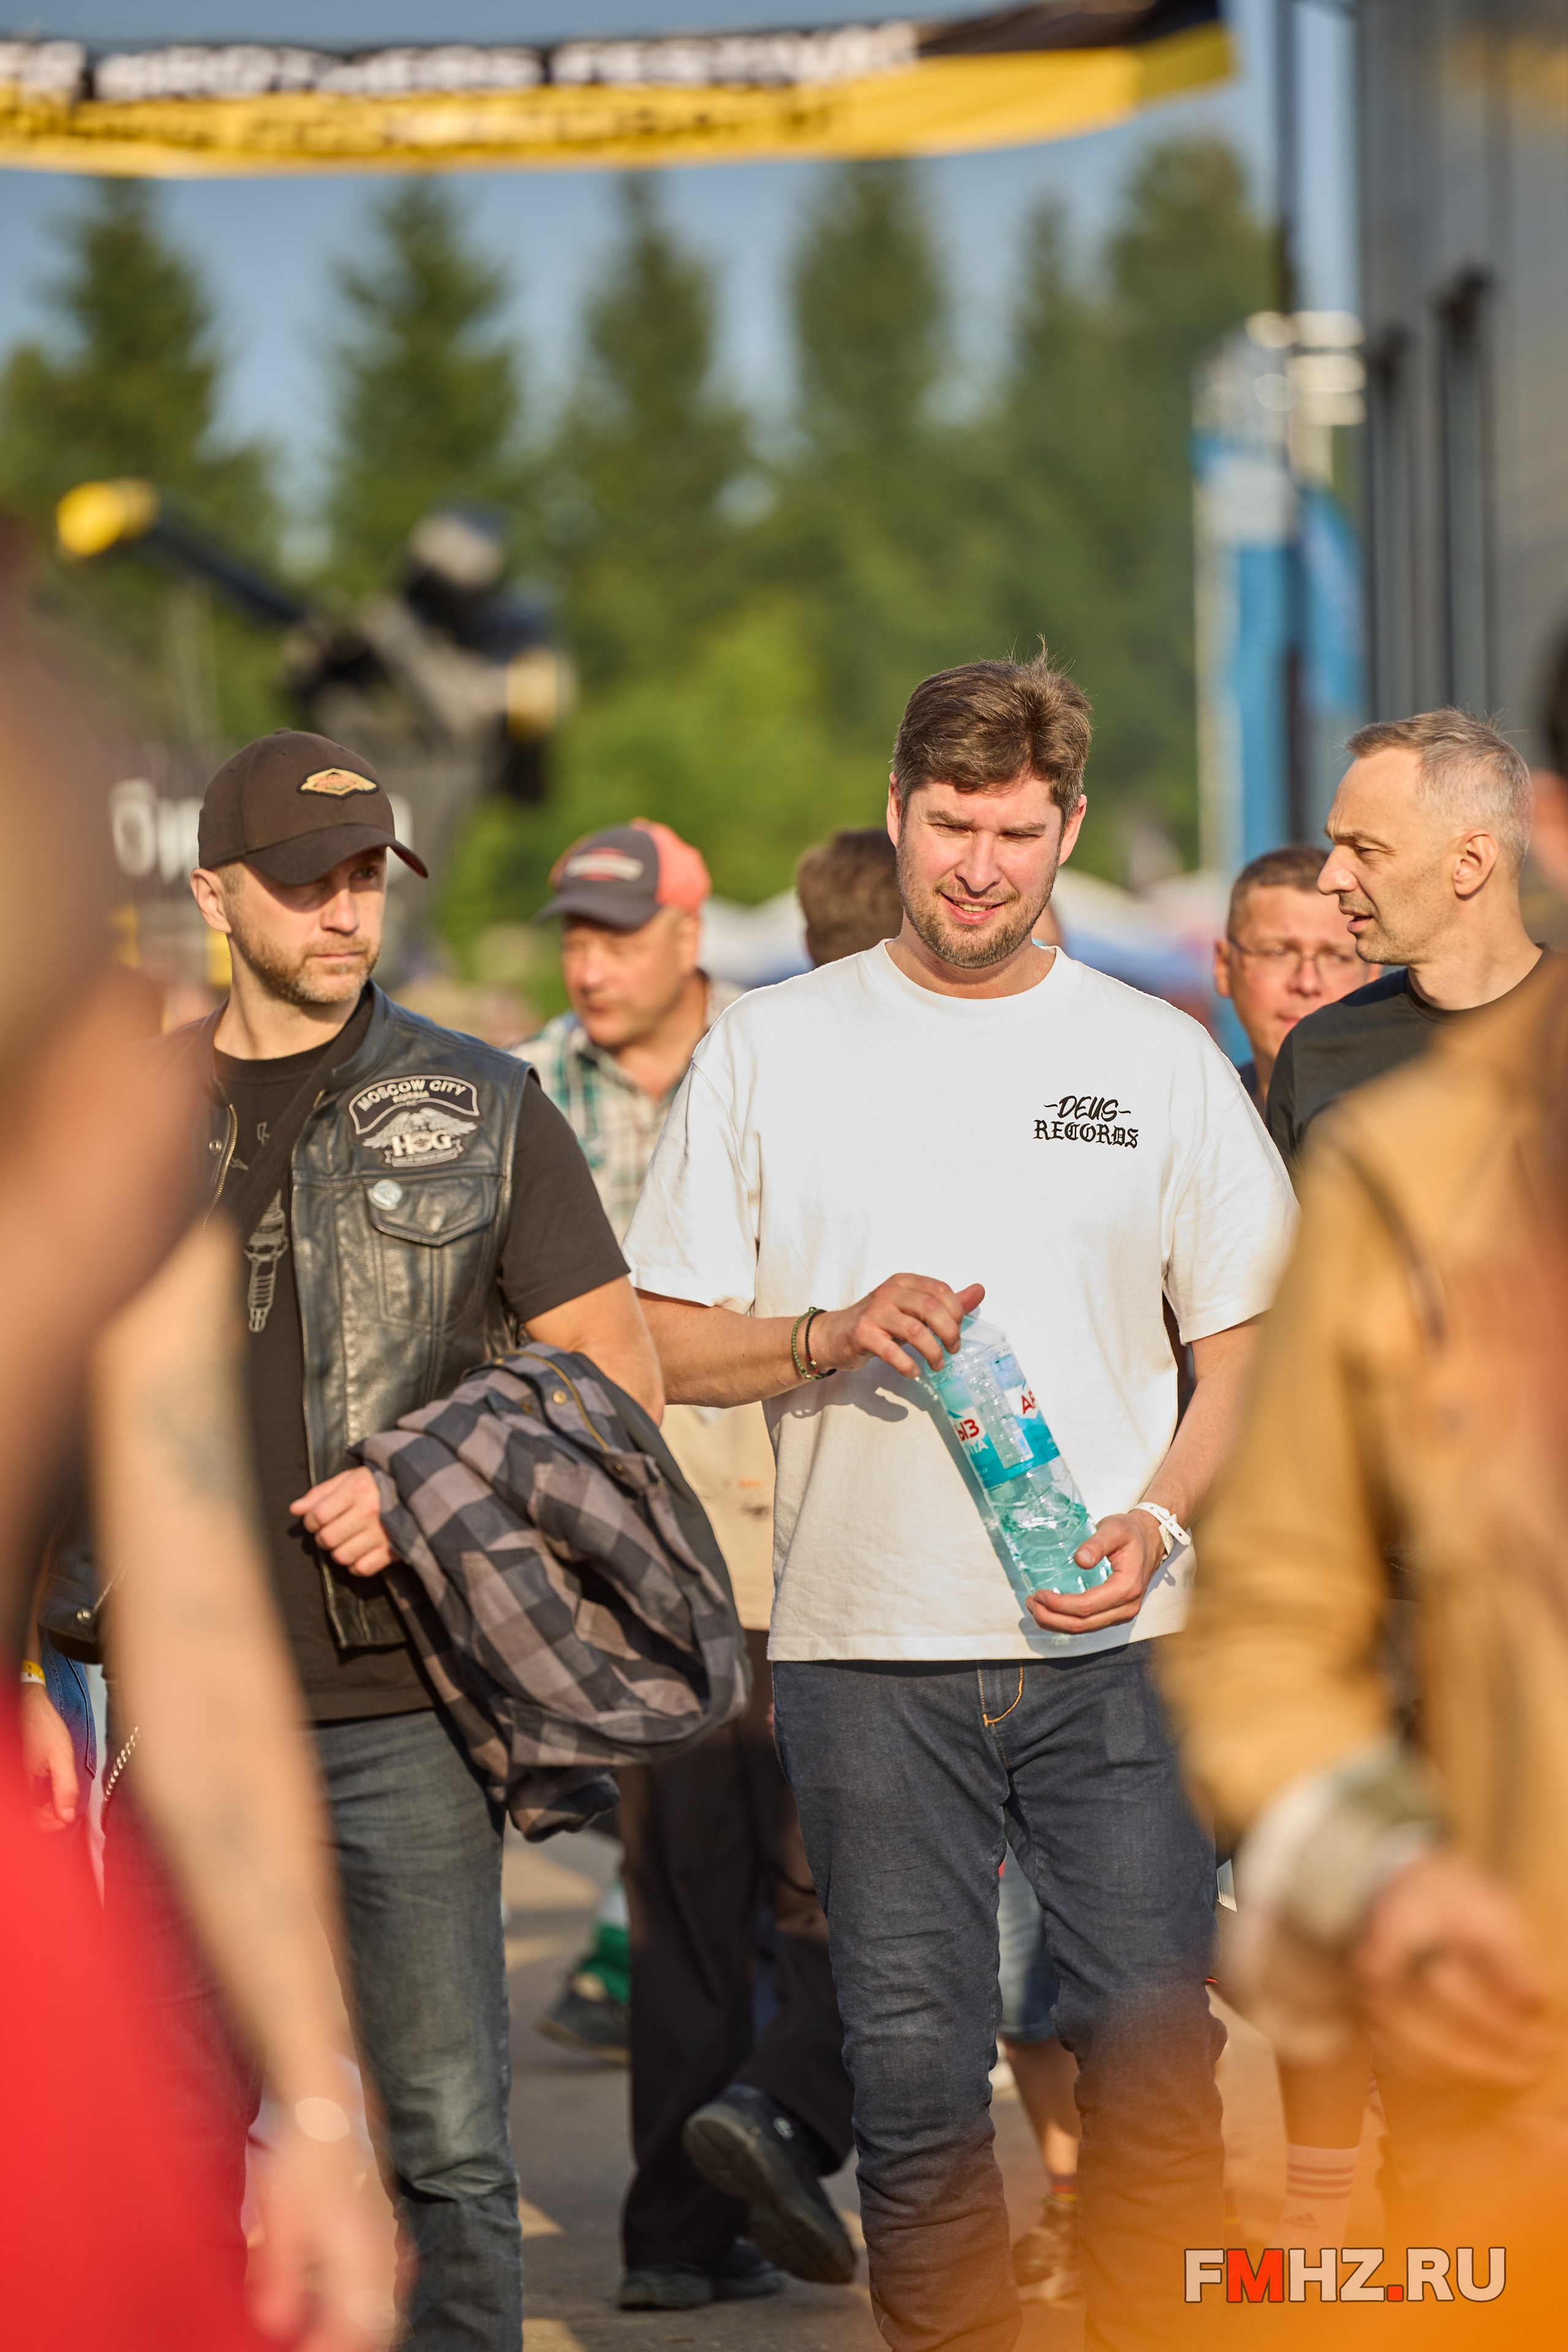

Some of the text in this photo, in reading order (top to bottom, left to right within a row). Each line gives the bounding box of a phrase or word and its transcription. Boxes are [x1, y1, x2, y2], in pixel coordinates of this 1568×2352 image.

[357, 1079, 467, 1112] MOSCOW CITY
[1033, 1120, 1139, 1149] RECORDS
